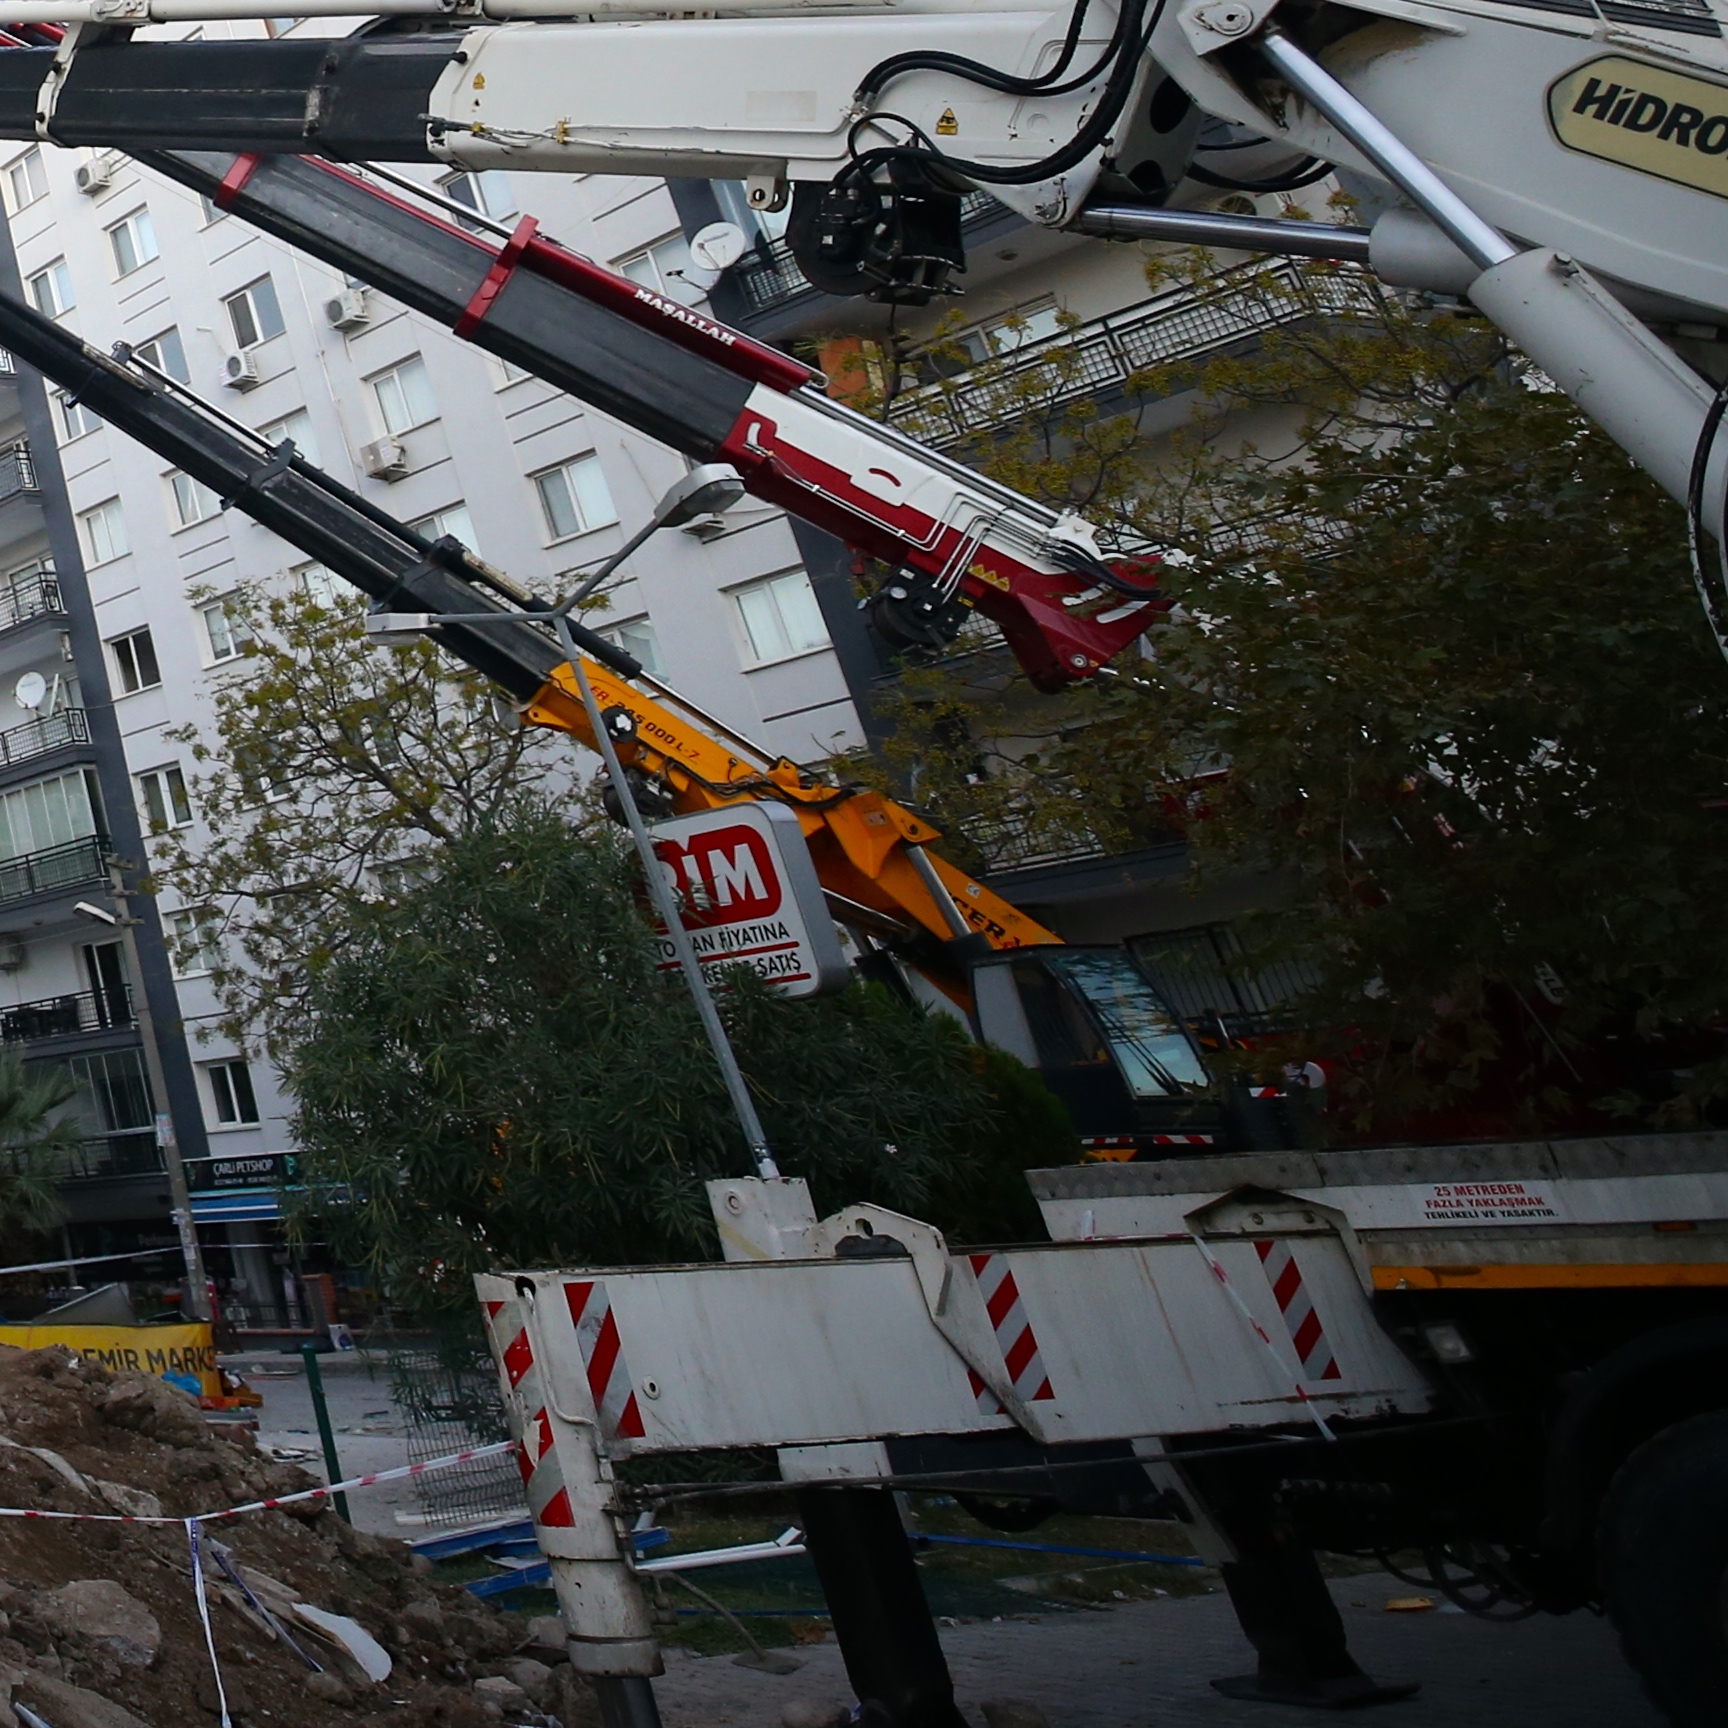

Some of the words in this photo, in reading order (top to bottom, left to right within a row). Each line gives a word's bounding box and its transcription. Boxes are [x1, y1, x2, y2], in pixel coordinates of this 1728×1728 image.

[1571, 75, 1728, 158] HİDRO
[633, 288, 737, 348] MAŞALLAH
[719, 921, 790, 949] FİYATINA
[757, 951, 802, 977] SATIŞ
[236, 1158, 274, 1174] PETSHOP
[1434, 1186, 1451, 1197] 25
[1454, 1183, 1525, 1197] METREDEN
[1425, 1198, 1465, 1210] FAZLA
[1466, 1196, 1545, 1209] YAKLAŞMAK
[1423, 1209, 1479, 1220] TEHLİKELİ
[1480, 1208, 1497, 1219] VE
